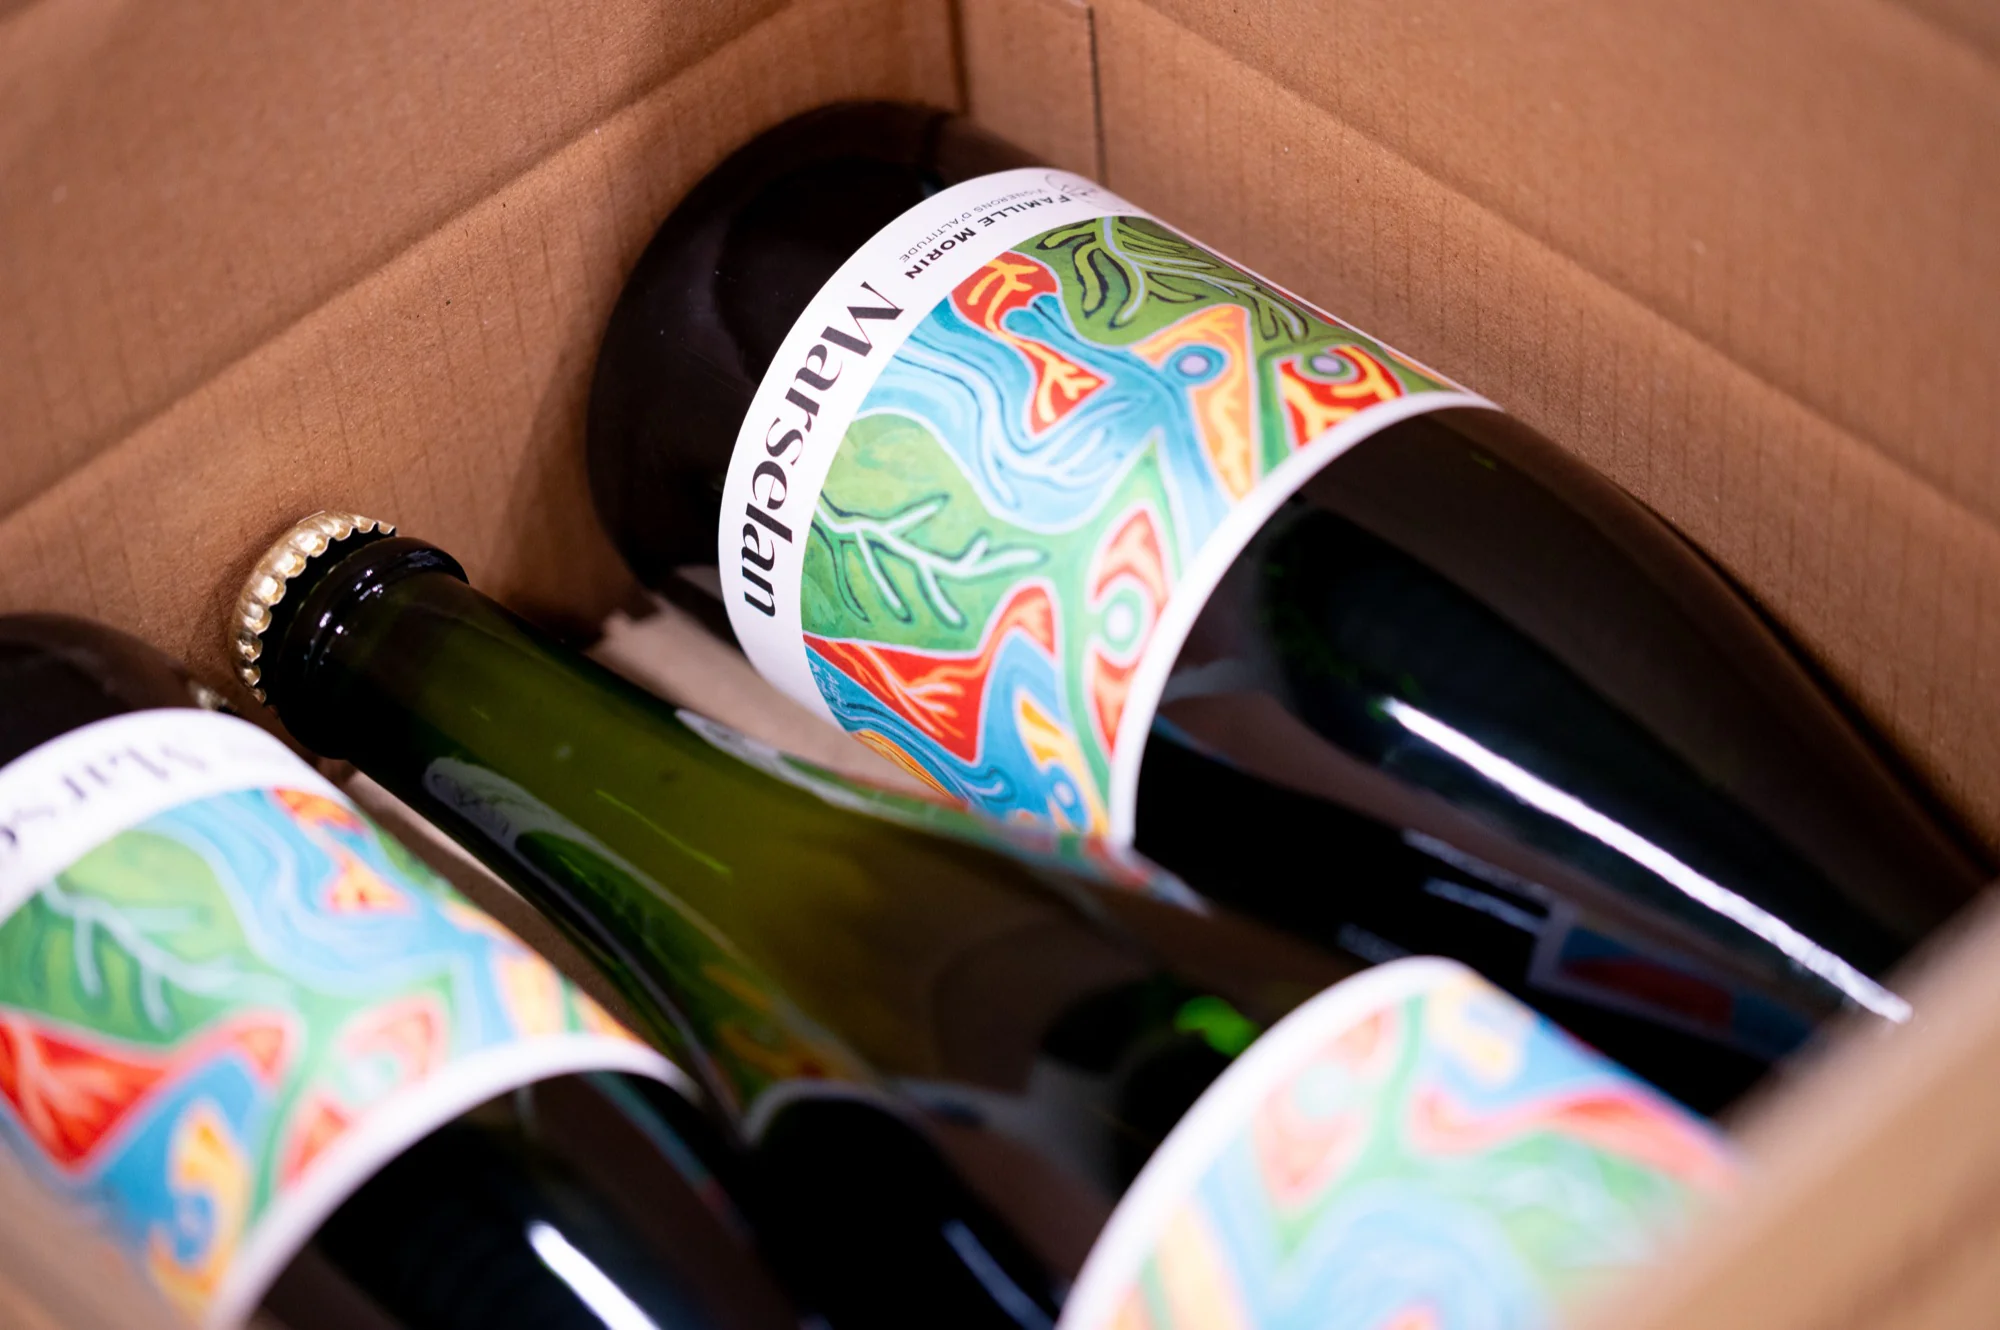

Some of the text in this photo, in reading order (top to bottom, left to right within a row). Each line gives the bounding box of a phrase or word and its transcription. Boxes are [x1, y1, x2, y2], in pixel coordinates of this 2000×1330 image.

[899, 212, 973, 262] D'ALTITUDE
[905, 193, 1071, 280] FAMILLE MORIN
[741, 281, 905, 617] Marselan
